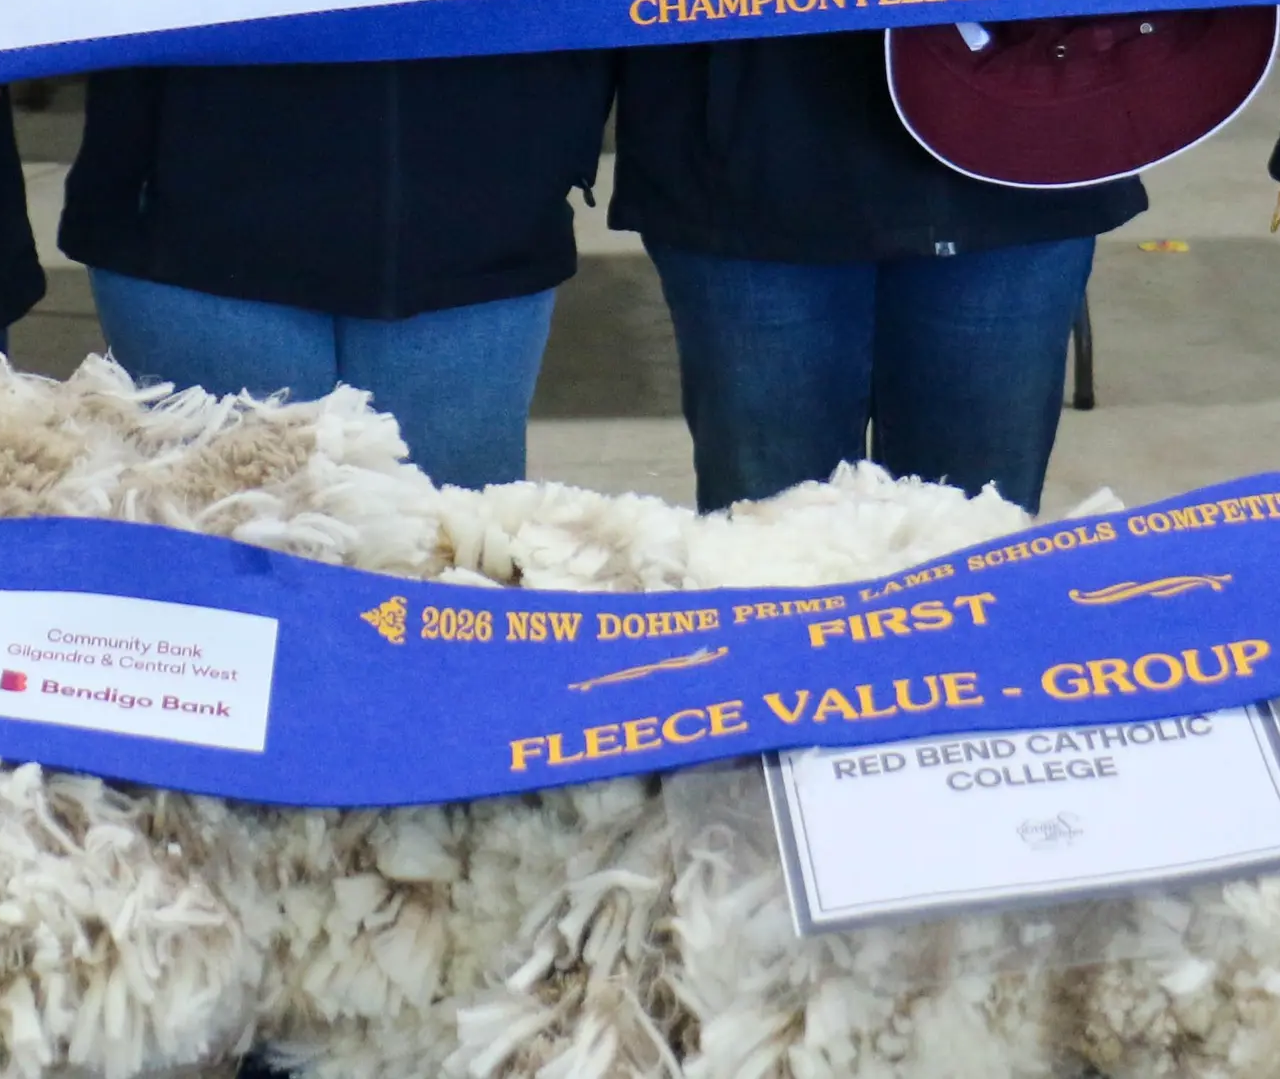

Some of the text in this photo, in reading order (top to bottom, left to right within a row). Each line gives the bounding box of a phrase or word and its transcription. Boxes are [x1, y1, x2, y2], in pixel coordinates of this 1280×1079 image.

[420, 606, 493, 642] 2026
[505, 611, 582, 642] NSW
[596, 607, 719, 641] DOHNE
[733, 594, 846, 626] PRIME
[859, 563, 955, 601] LAMB
[967, 521, 1118, 573] SCHOOLS
[46, 628, 204, 659] Community Bank
[806, 591, 998, 648] FIRST
[7, 643, 238, 682] Gilgandra & Central West
[40, 679, 231, 718] Bendigo Bank
[508, 699, 749, 772] FLEECE
[762, 672, 984, 725] VALUE
[1040, 637, 1271, 702] GROUP
[832, 714, 1214, 781] RED BEND CATHOLIC
[945, 756, 1119, 793] COLLEGE
